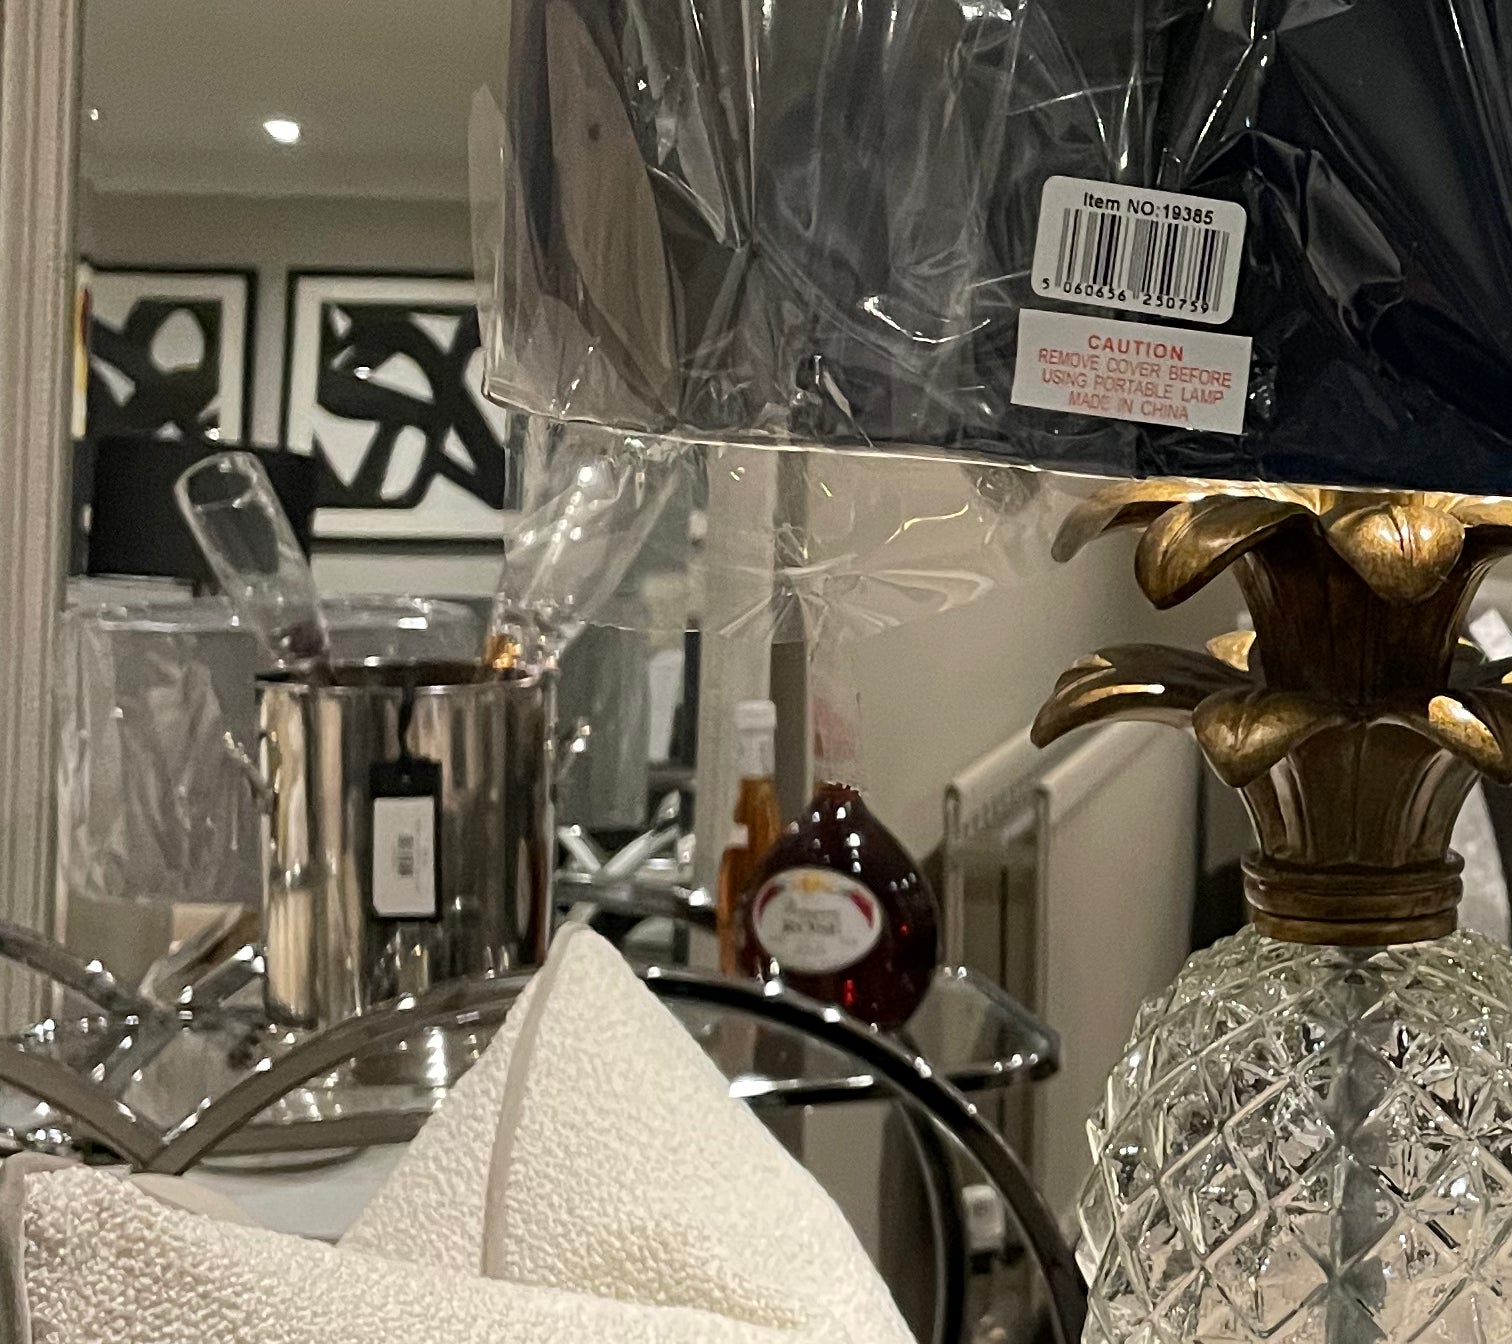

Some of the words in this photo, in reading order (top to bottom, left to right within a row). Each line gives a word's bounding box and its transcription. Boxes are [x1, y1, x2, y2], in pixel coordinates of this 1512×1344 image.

[1083, 192, 1120, 212] Item
[1127, 198, 1215, 225] NO:19385
[1041, 278, 1050, 289] 5
[1063, 282, 1127, 302] 060656
[1142, 293, 1210, 314] 250759
[1087, 334, 1184, 361] CAUTION
[1038, 348, 1099, 371] REMOVE
[1106, 357, 1161, 378] COVER
[1168, 365, 1232, 389] BEFORE
[1041, 368, 1087, 388] USING
[1093, 374, 1174, 400] PORTABLE
[1181, 386, 1225, 404] LAMP
[1068, 391, 1110, 410] MADE
[1117, 398, 1133, 414] IN
[1141, 403, 1189, 421] CHINA
